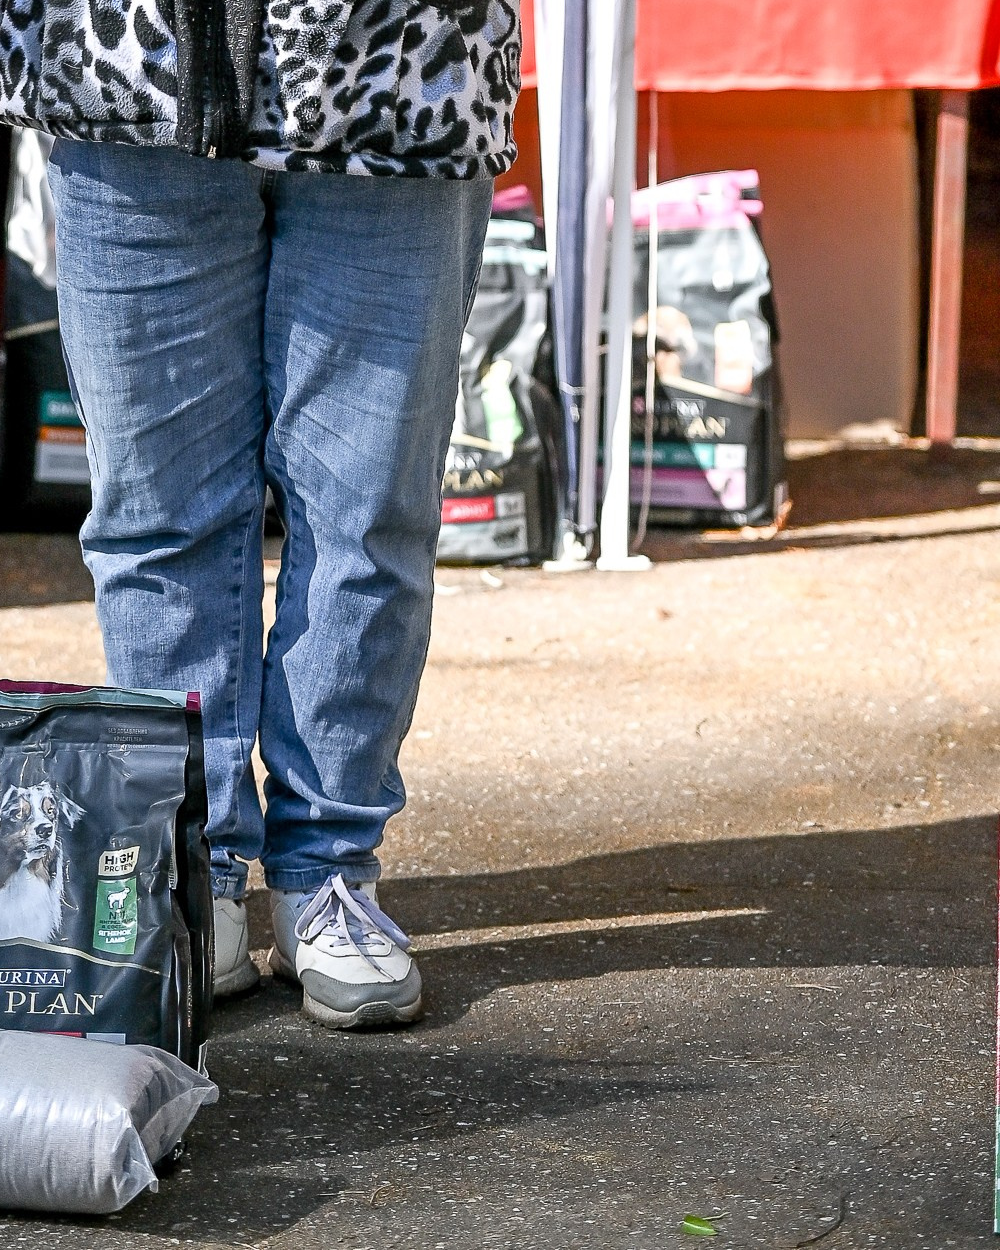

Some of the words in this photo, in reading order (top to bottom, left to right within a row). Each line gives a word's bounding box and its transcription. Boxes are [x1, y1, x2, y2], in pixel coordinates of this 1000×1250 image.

[104, 851, 135, 866] HIGH
[105, 936, 126, 944] LAMB
[3, 990, 98, 1016] PLAN
